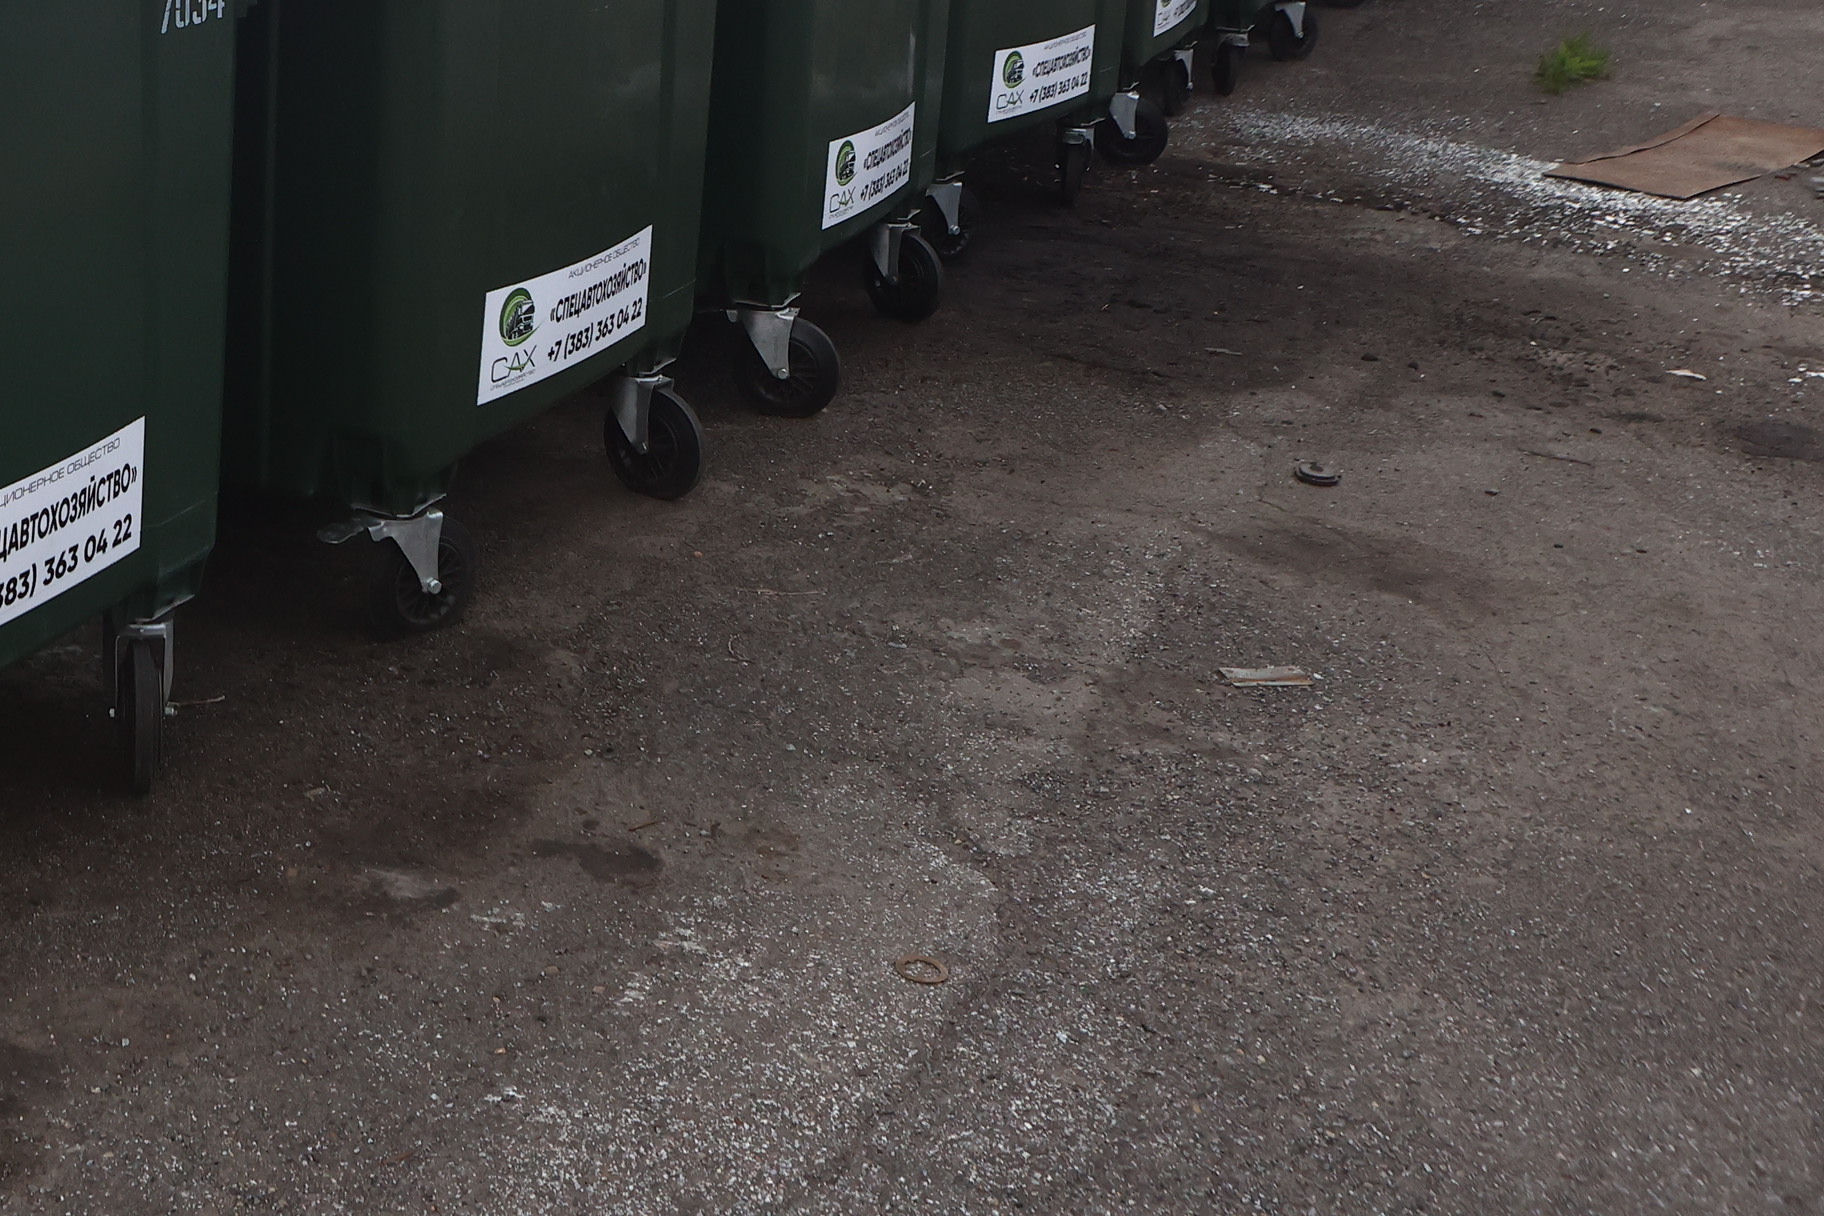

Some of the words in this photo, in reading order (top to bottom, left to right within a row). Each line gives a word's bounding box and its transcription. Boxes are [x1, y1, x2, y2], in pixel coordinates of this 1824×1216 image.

[550, 258, 648, 323] «СПЕЦАВТОХОЗЯЙСТВО»
[547, 340, 562, 362] +7
[563, 322, 594, 359] (383)
[595, 313, 615, 341] 363
[616, 306, 630, 330] 04
[630, 297, 643, 322] 22
[490, 344, 538, 383] САХ
[66, 437, 121, 474] ОБЩЕСТВО
[42, 547, 78, 586] 363
[83, 529, 108, 562] 04
[112, 513, 133, 549] 22
